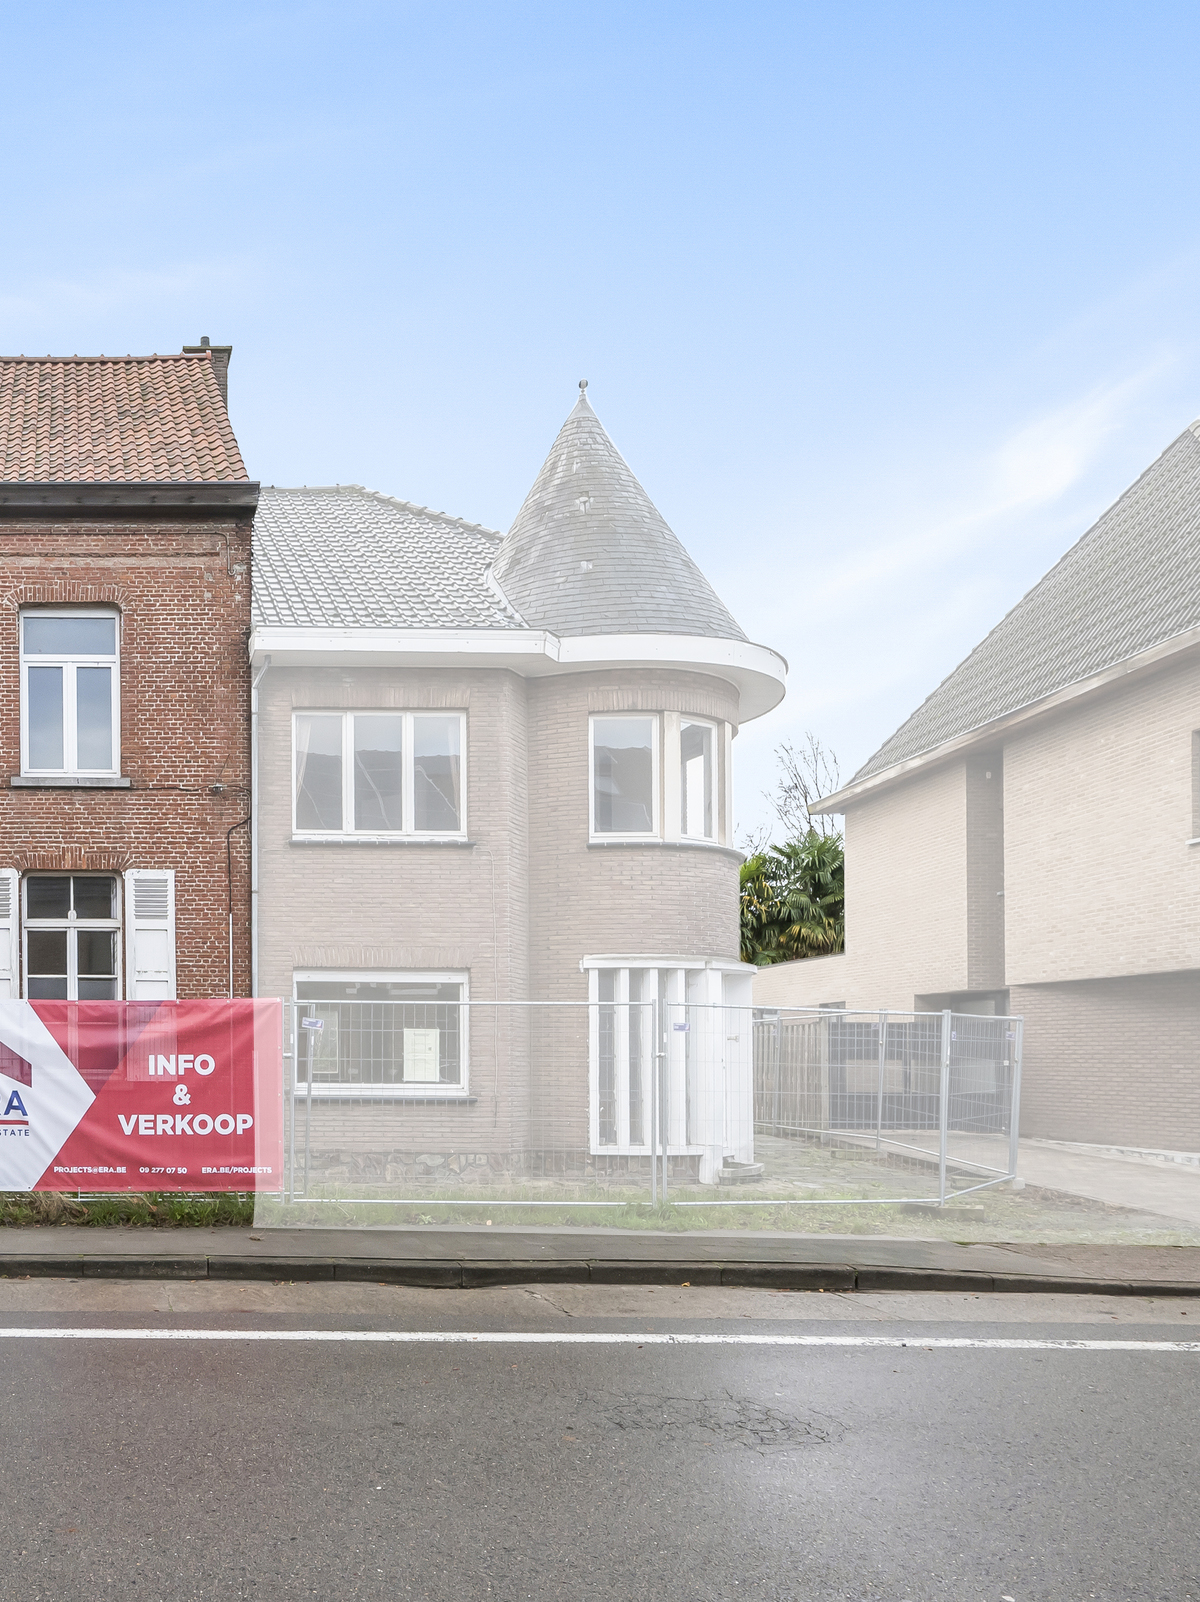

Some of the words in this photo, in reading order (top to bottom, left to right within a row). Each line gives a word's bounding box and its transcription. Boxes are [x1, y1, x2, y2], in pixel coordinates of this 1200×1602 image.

[148, 1054, 215, 1076] INFO
[172, 1084, 191, 1106] &
[117, 1114, 254, 1135] VERKOOP
[53, 1166, 127, 1174] PROJECTS@ERA.BE
[139, 1166, 150, 1174] 09
[201, 1166, 273, 1174] ERA.BE/PROJECTS
